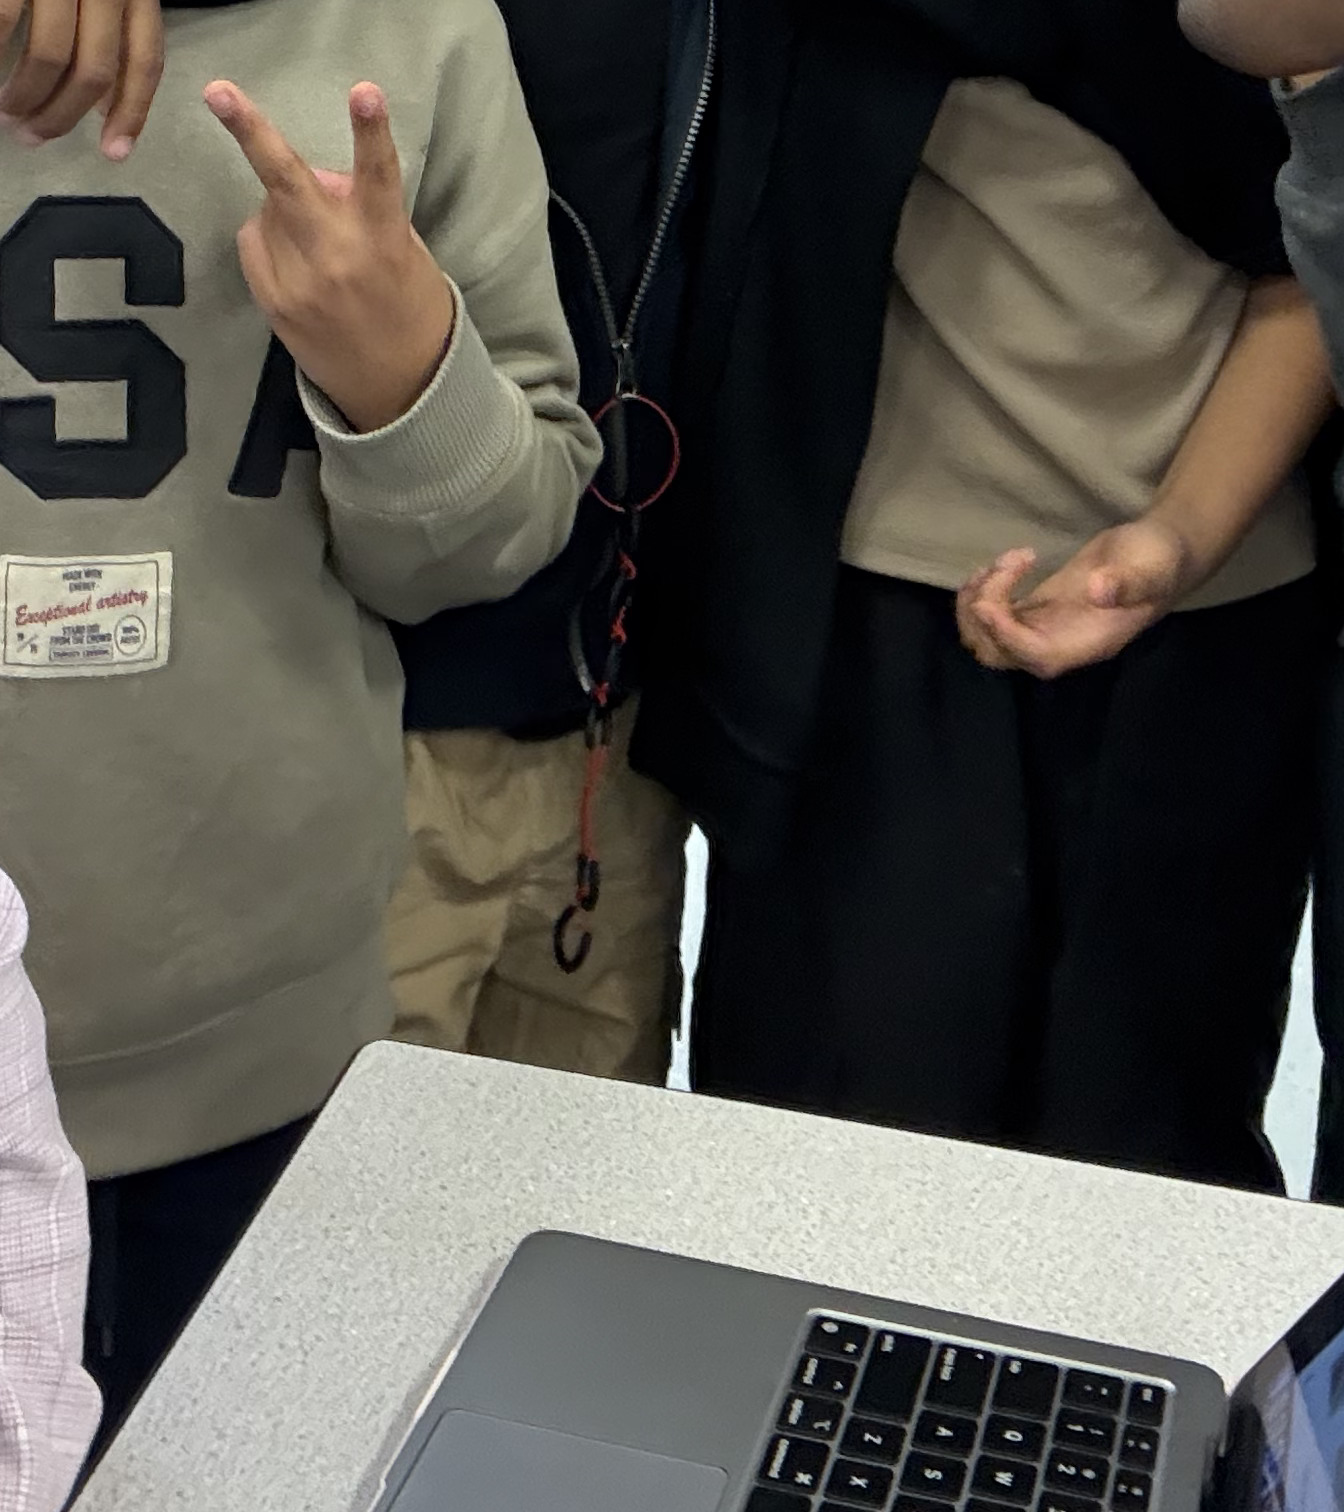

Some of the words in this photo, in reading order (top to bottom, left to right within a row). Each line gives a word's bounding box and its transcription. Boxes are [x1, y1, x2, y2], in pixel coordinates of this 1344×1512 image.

[15, 594, 92, 627] Exceptional
[96, 589, 149, 610] artistry
[935, 1426, 954, 1437] A
[1003, 1429, 1024, 1442] Q
[864, 1432, 883, 1445] Z
[923, 1468, 944, 1481] S
[1057, 1463, 1077, 1476] 2
[849, 1475, 869, 1489] X
[994, 1471, 1014, 1487] W
